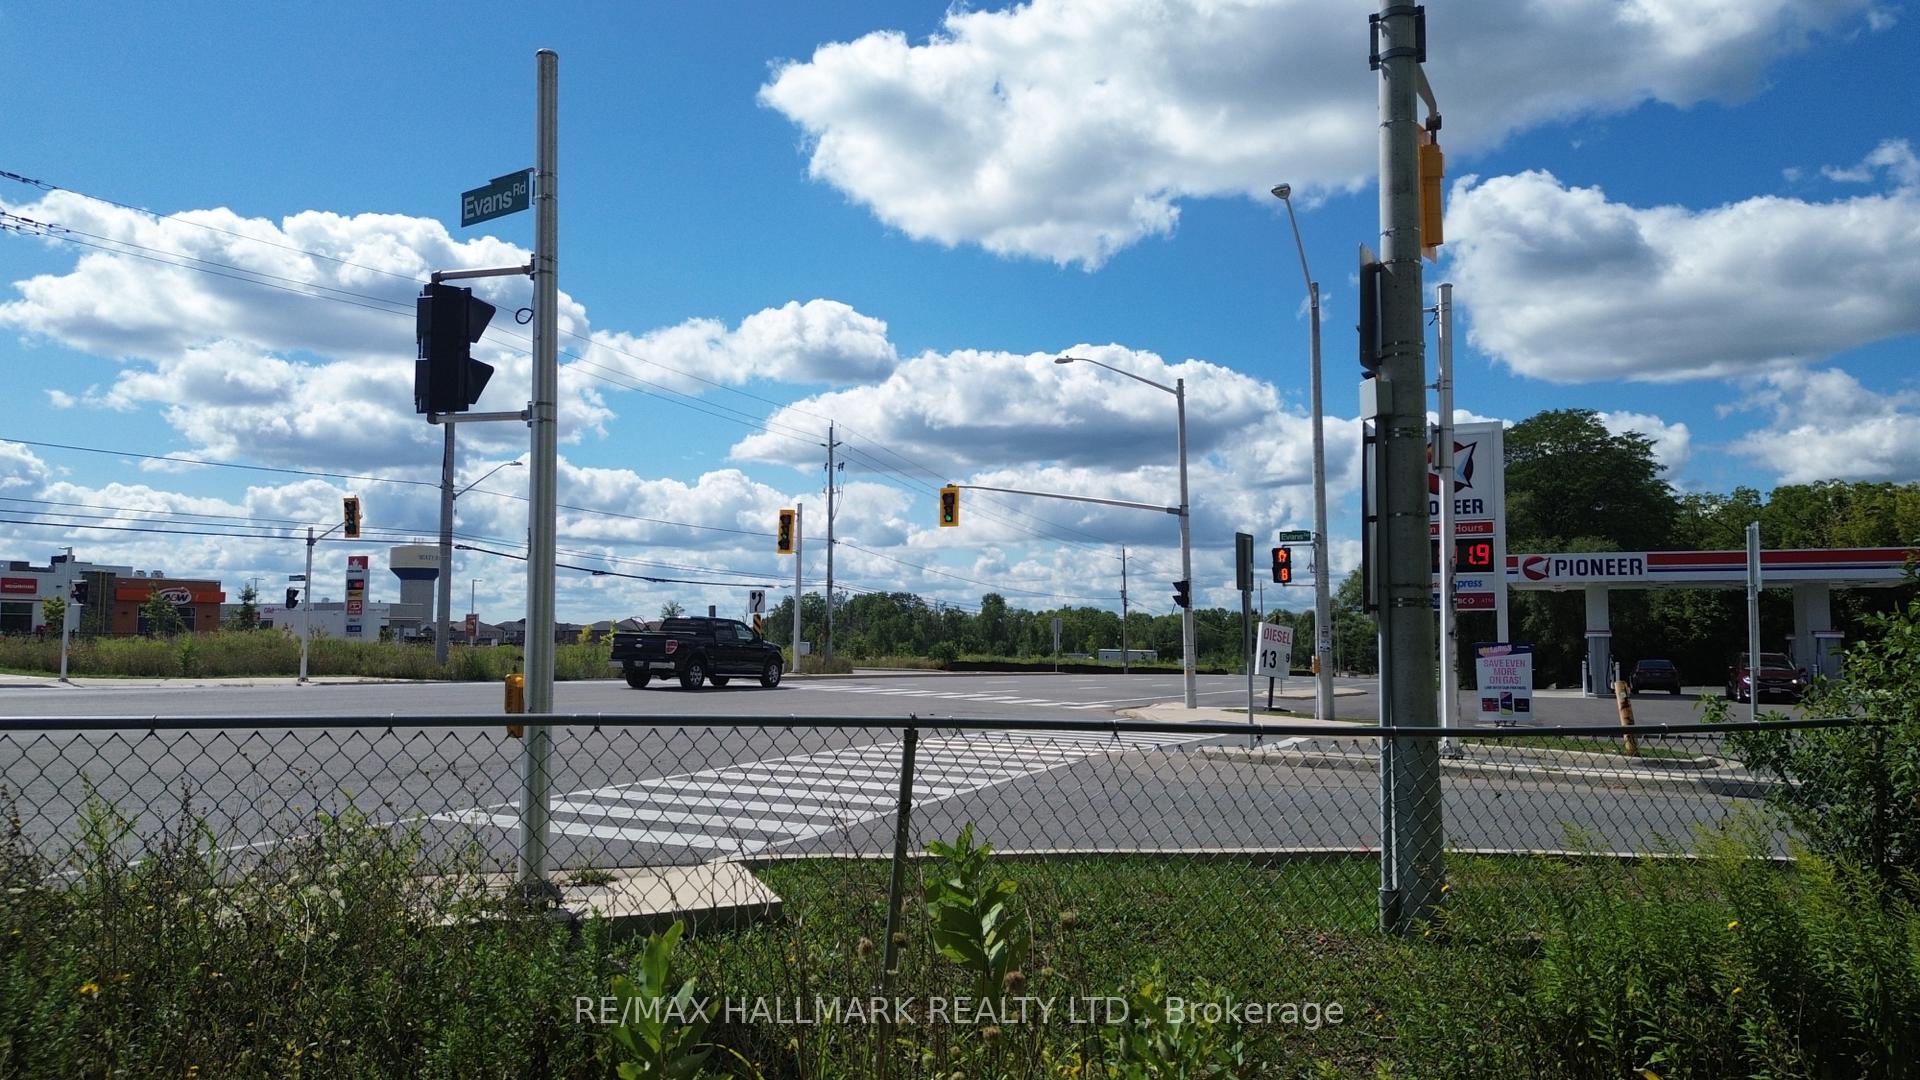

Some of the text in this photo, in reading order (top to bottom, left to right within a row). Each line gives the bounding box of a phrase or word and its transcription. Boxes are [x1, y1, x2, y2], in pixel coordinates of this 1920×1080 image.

[464, 181, 527, 219] Evans Rd
[1429, 499, 1484, 516] OEER
[1554, 558, 1644, 577] PIONEER
[1456, 580, 1483, 590] press
[1264, 628, 1291, 645] DIESEL
[1262, 649, 1277, 668] 13
[1483, 659, 1526, 668] SAVE EVEN
[1489, 676, 1521, 684] ON GAS!
[1493, 667, 1517, 676] MORE
